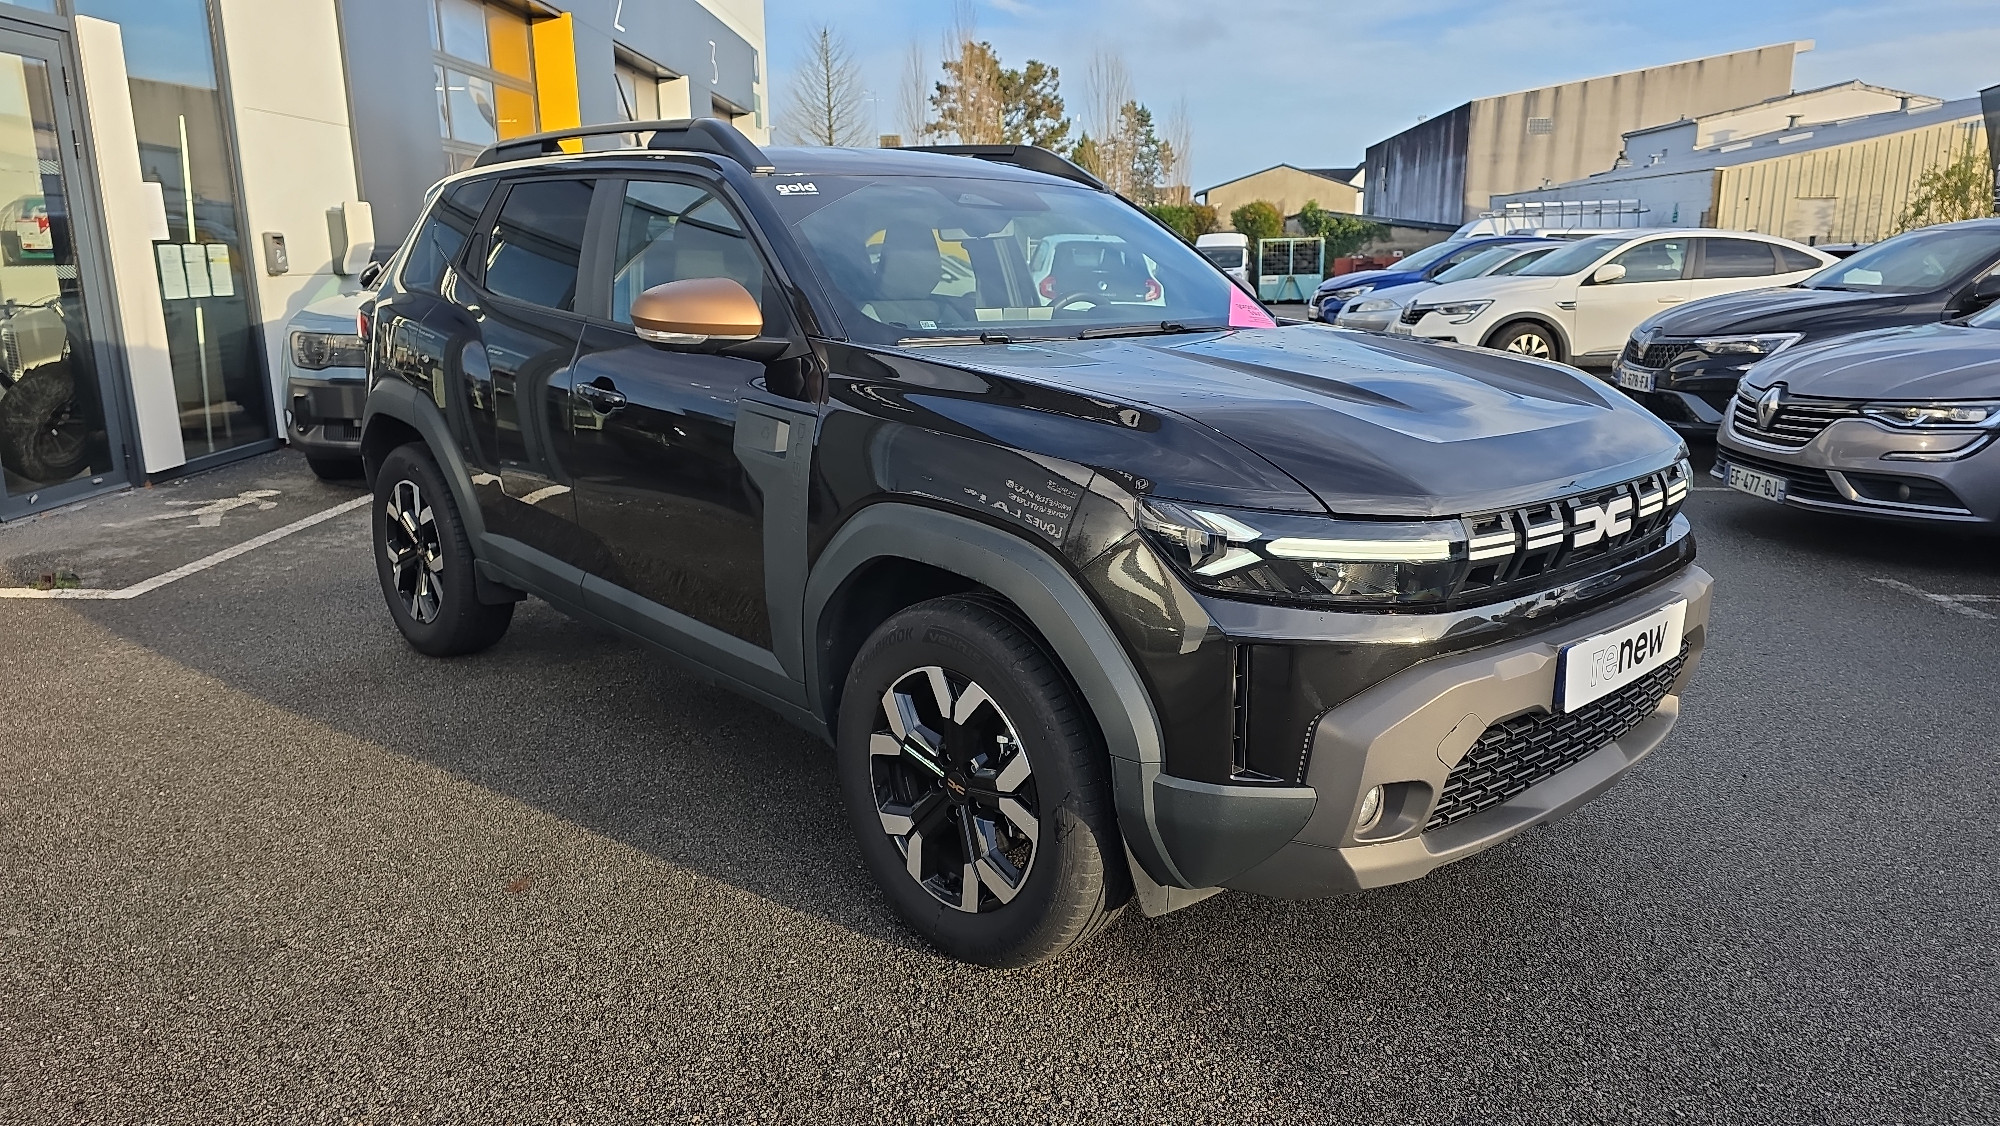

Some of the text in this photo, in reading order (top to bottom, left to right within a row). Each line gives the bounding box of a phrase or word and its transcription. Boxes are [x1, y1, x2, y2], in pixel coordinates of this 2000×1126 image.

[708, 40, 719, 85] 3
[775, 182, 818, 194] gold
[1730, 467, 1778, 498] EF-477-GJ
[1590, 620, 1668, 688] renew
